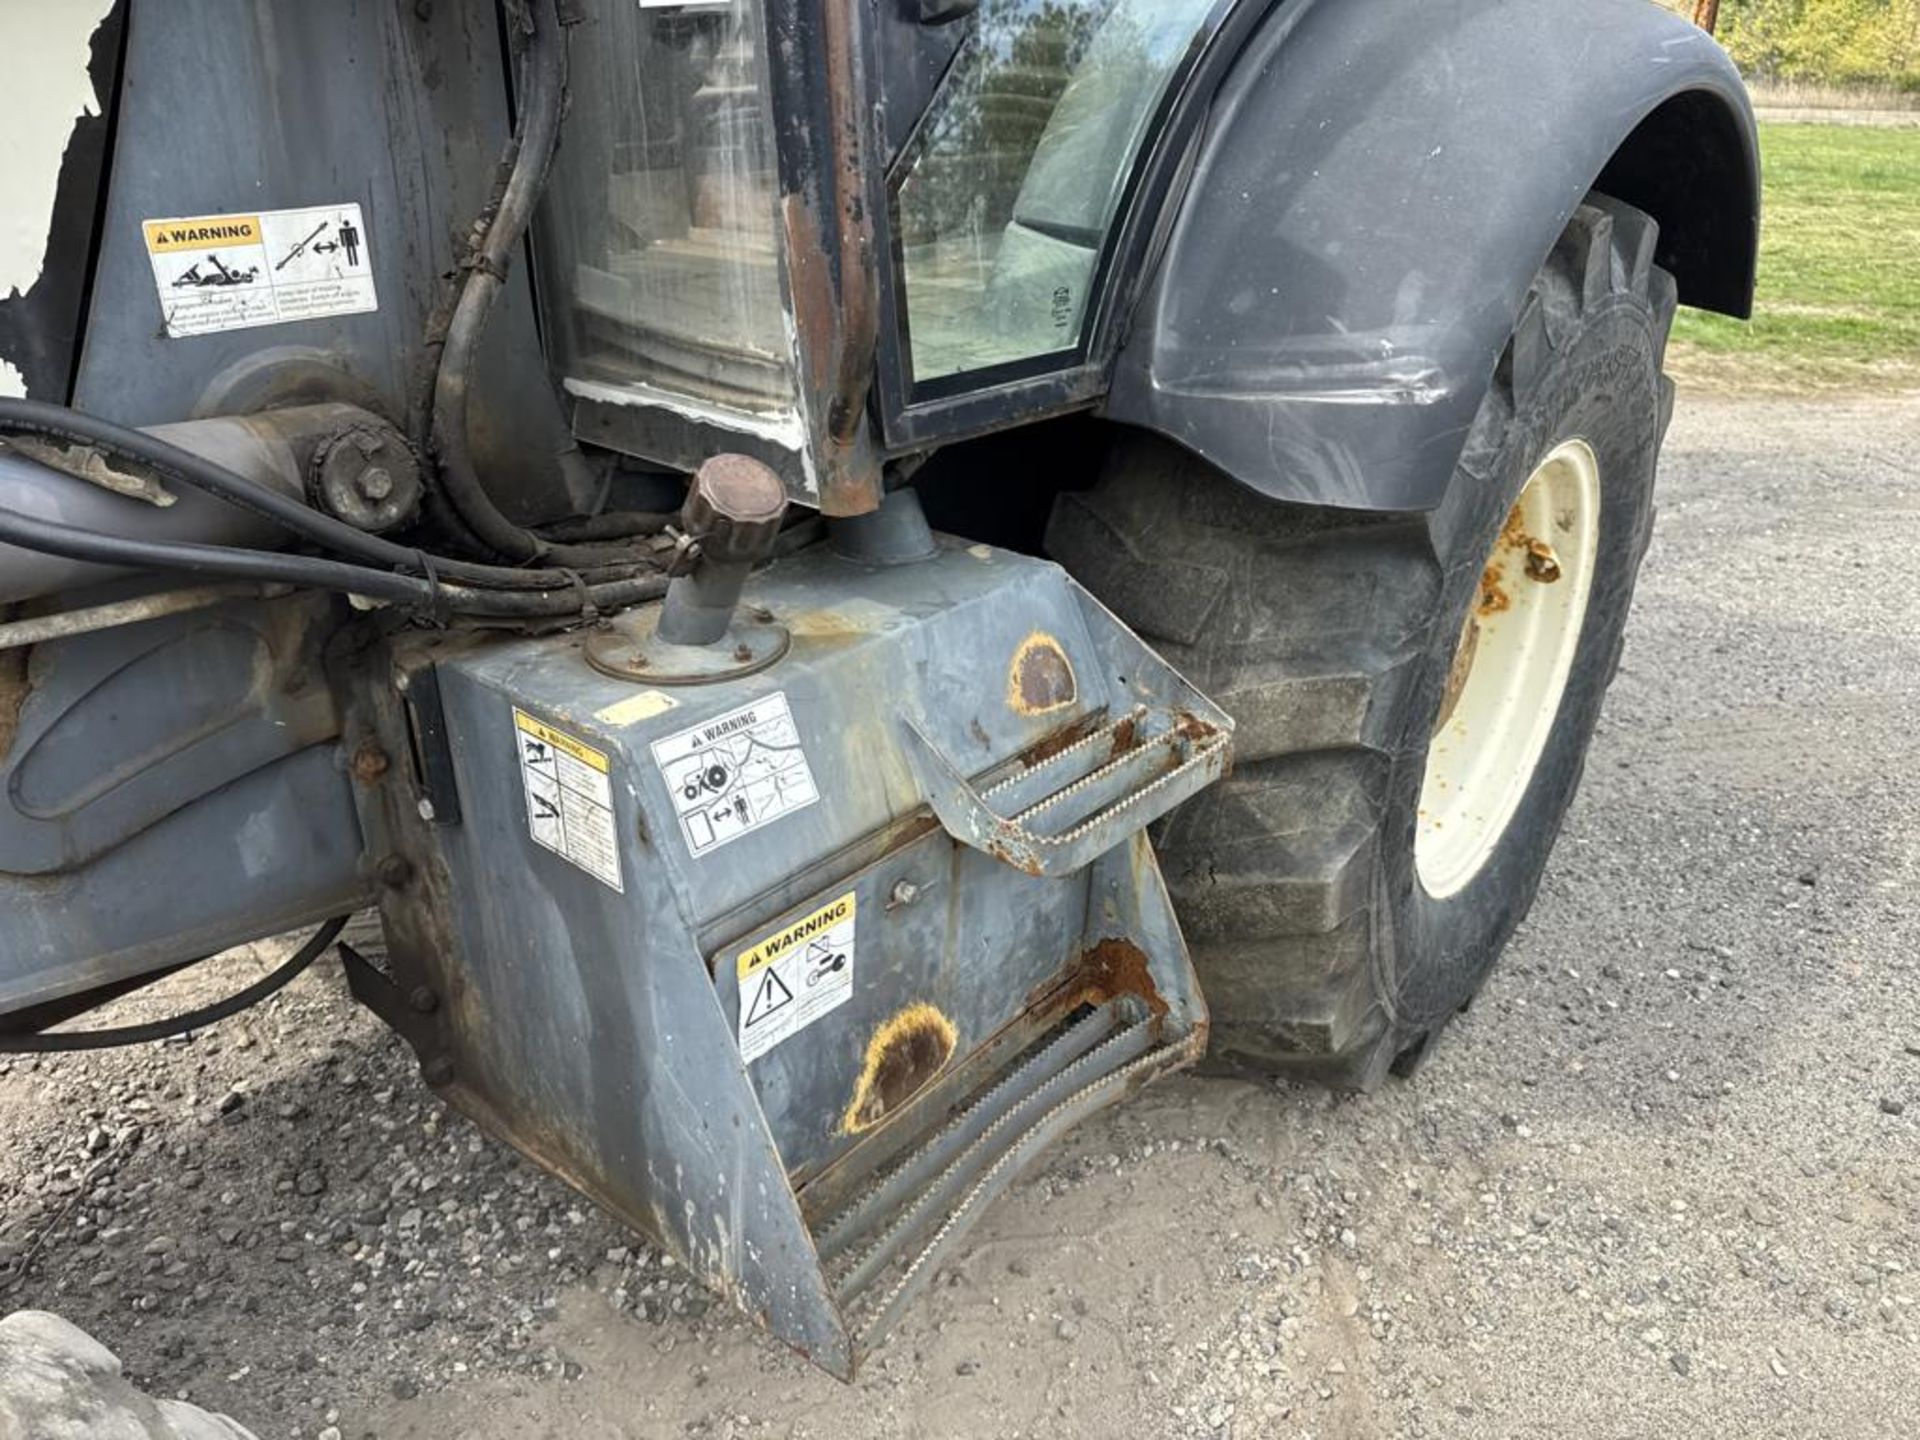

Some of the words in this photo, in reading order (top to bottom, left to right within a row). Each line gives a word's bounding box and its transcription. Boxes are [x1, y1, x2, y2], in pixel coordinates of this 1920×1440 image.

[171, 224, 252, 243] WARNING
[703, 711, 757, 742] WARNING
[765, 902, 847, 958] WARNING
